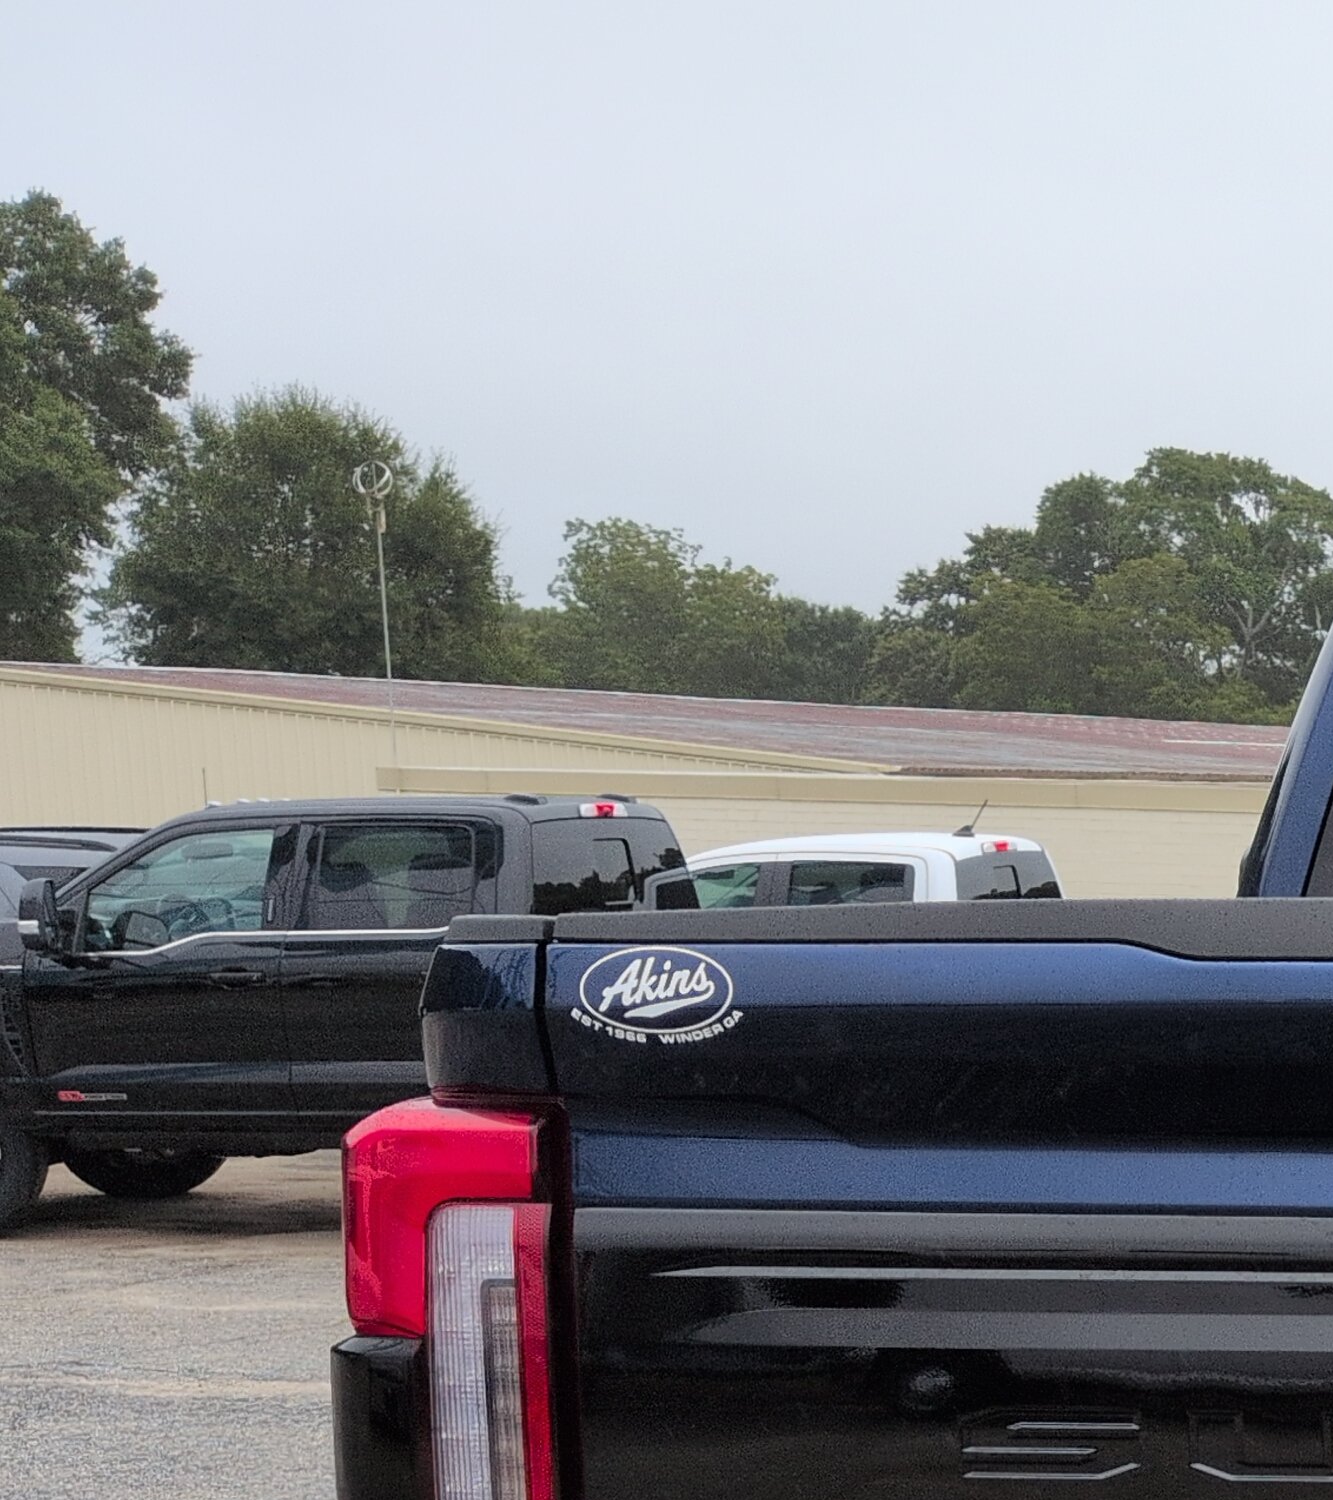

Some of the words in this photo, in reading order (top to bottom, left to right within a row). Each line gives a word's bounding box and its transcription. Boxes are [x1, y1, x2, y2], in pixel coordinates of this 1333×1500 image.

[598, 957, 715, 1018] Akins
[570, 1007, 603, 1031] EST
[605, 1026, 647, 1043] 1966
[658, 1023, 724, 1044] WINDER
[722, 1010, 744, 1029] GA
